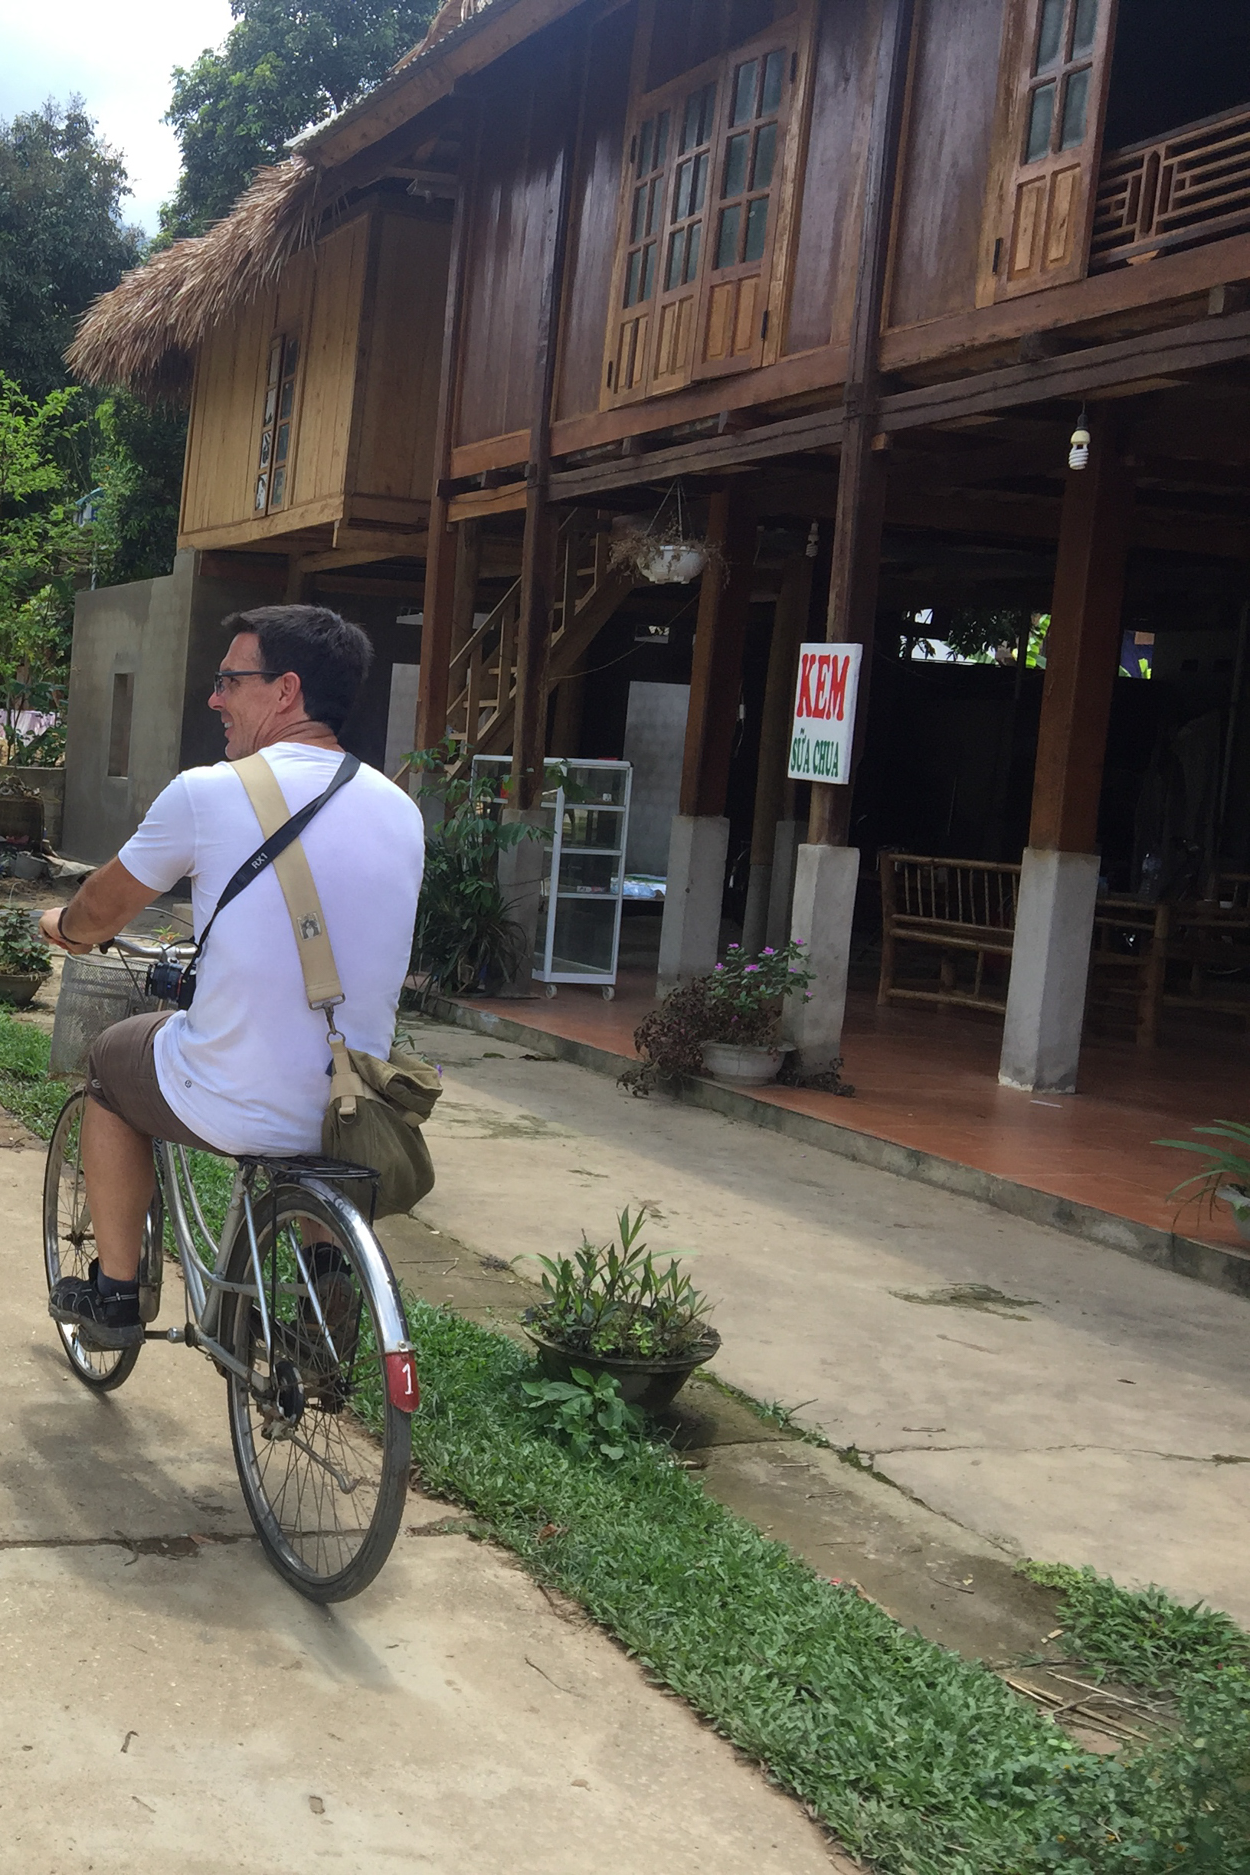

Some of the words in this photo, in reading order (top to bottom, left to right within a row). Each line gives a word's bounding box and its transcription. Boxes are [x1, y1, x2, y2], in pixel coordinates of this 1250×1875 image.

[796, 653, 851, 722] KEM
[790, 728, 810, 774] SỮA
[812, 739, 839, 778] CHUA
[251, 852, 268, 869] RX1
[402, 1362, 414, 1395] 1
